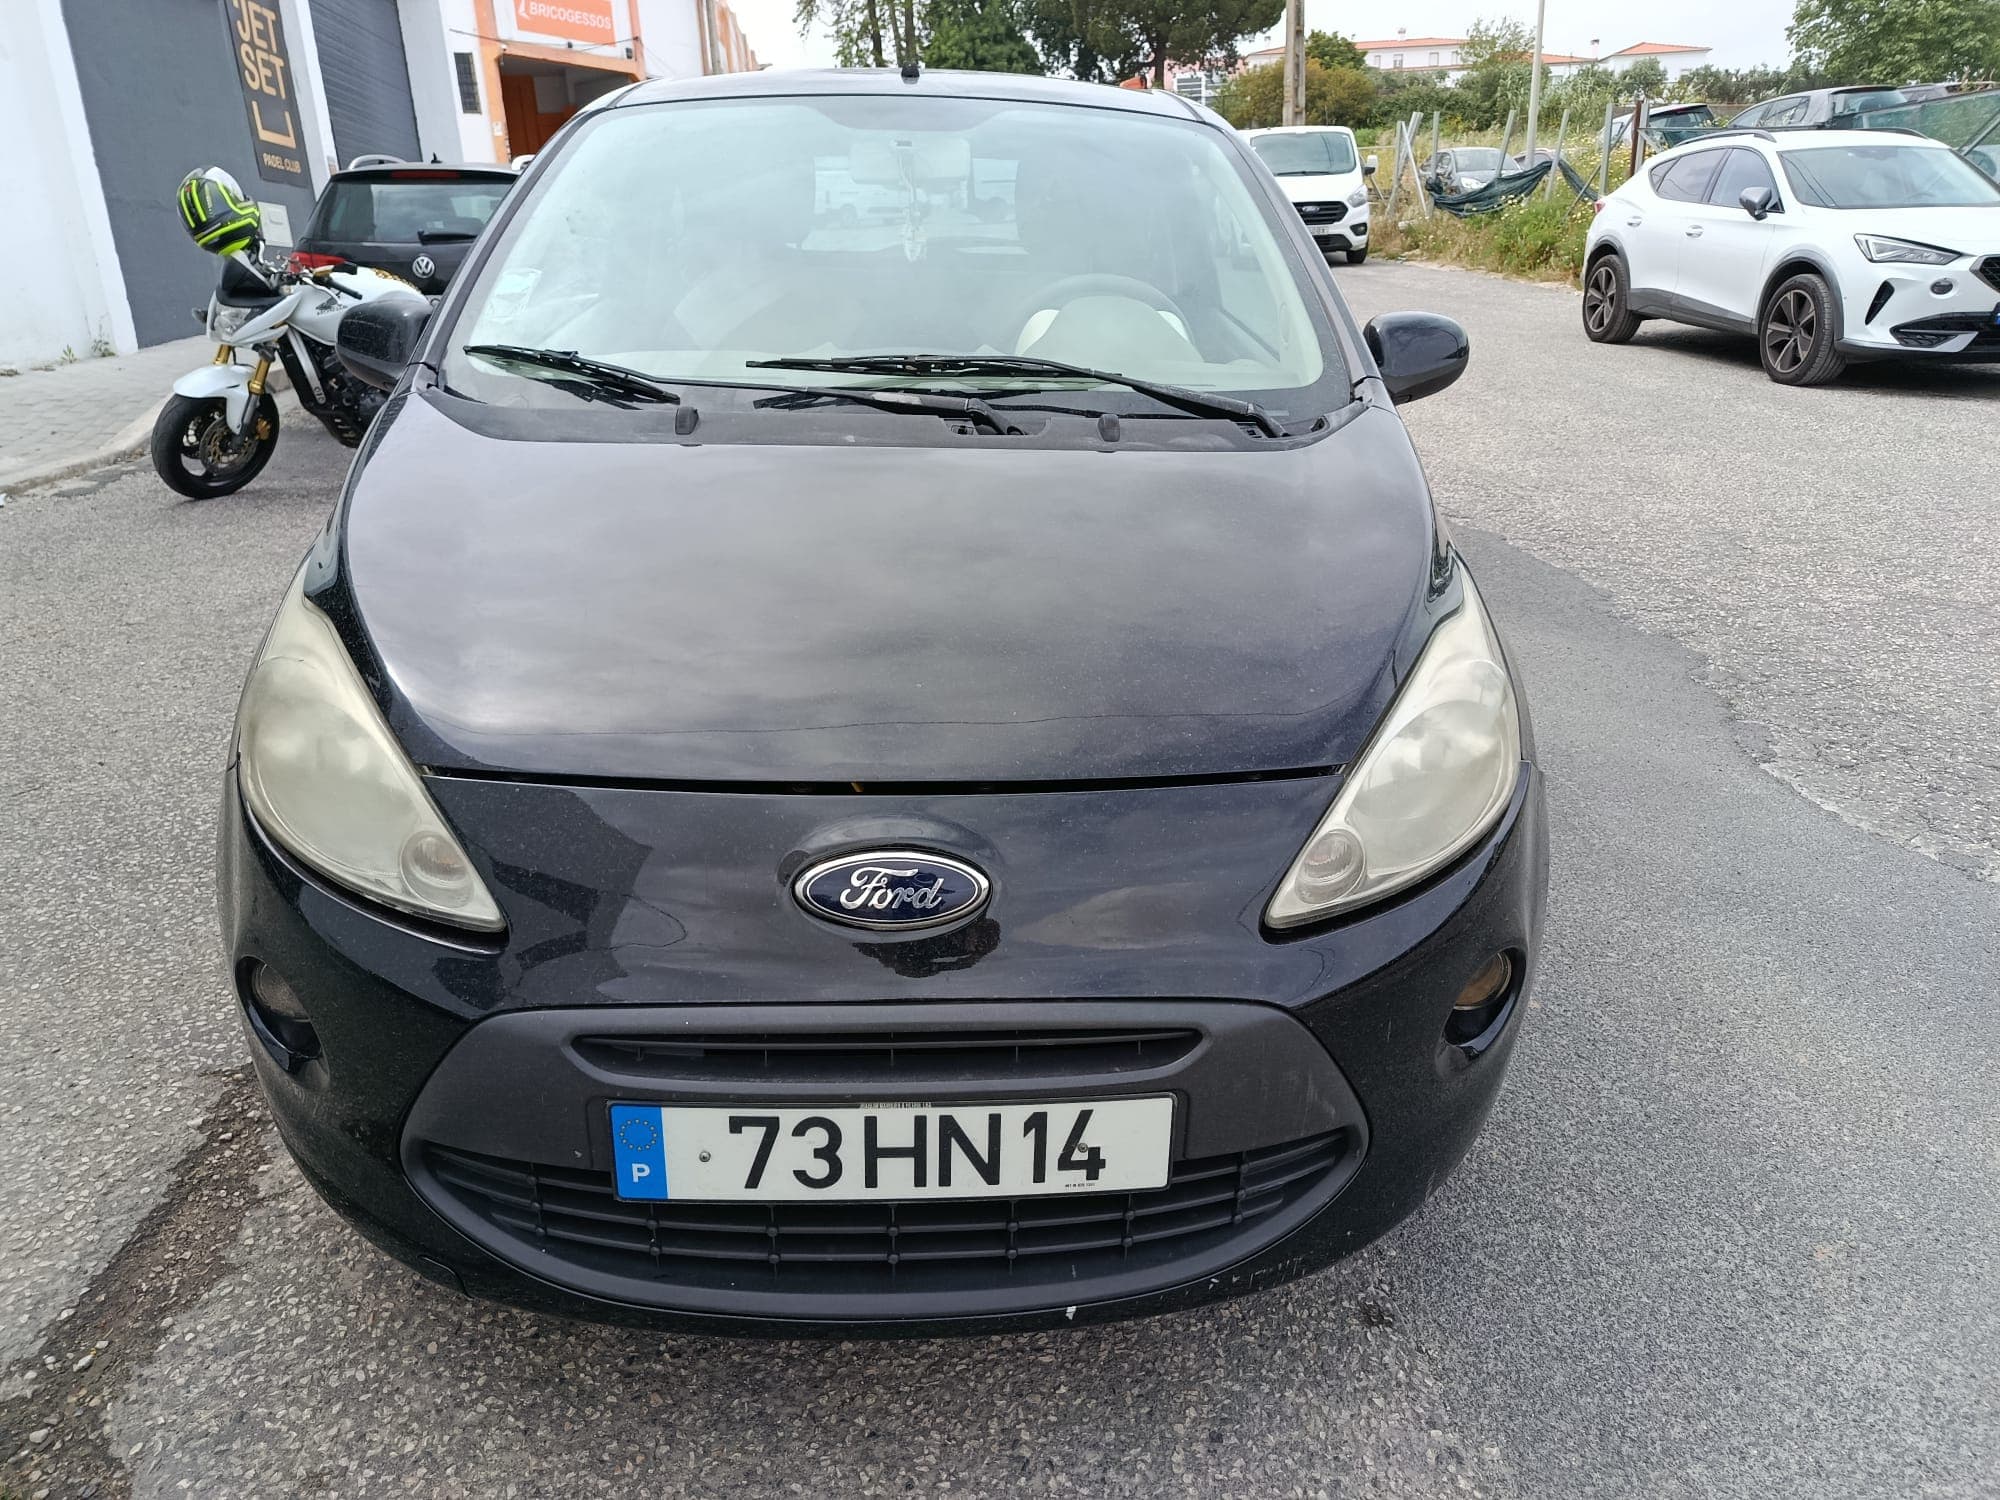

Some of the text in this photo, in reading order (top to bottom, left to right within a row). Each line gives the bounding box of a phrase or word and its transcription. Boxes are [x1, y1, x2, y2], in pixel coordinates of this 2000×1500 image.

[233, 0, 276, 54] JET
[529, 1, 612, 30] BRICOGESSOS
[240, 43, 284, 99] SET
[263, 152, 302, 174] PADEL CLUB
[840, 866, 944, 910] Ford
[632, 1163, 650, 1183] P
